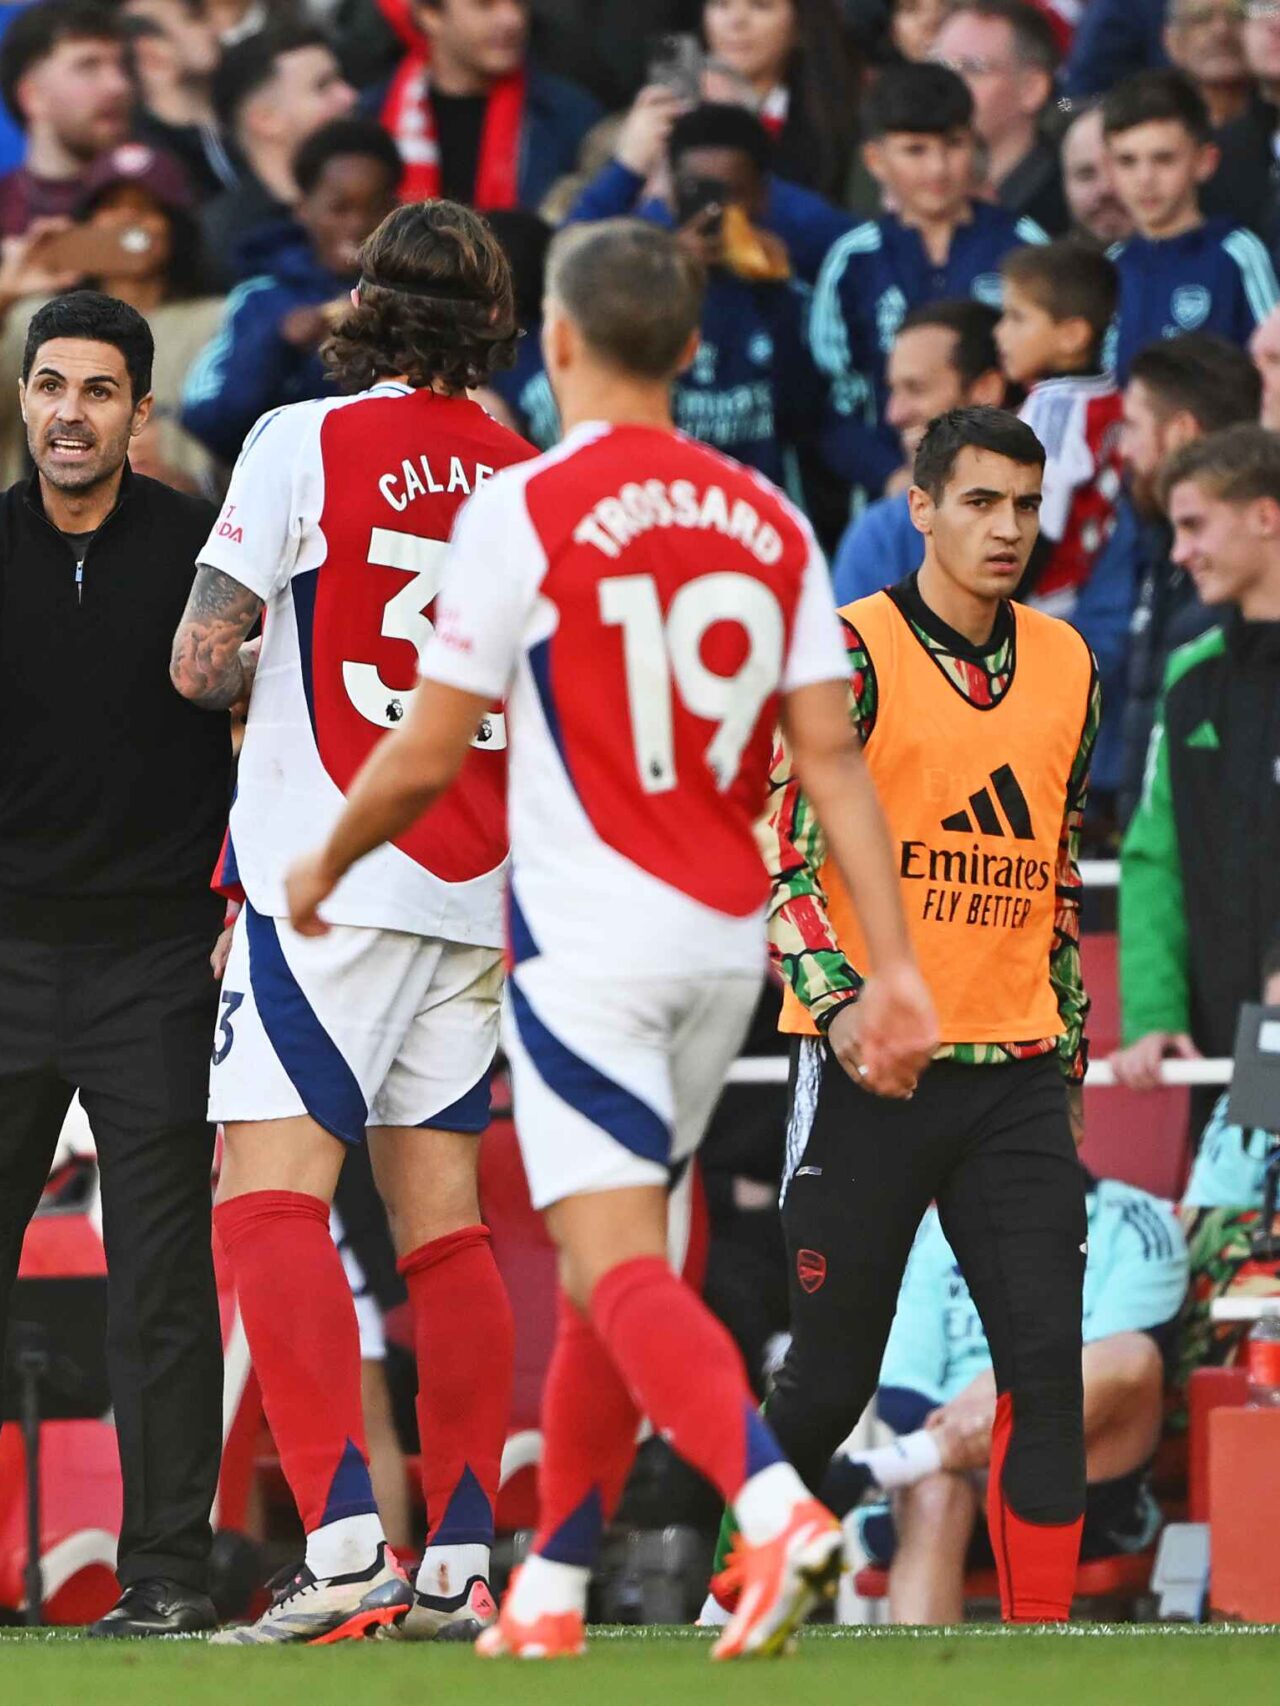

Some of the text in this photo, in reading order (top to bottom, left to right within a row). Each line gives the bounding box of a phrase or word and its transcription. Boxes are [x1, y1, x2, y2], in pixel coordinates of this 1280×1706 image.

[377, 454, 495, 512] CALAF
[573, 477, 784, 566] TROSSARD
[597, 571, 785, 795] 19
[900, 840, 1050, 891] Emirates
[923, 888, 1031, 928] FLY BETTER
